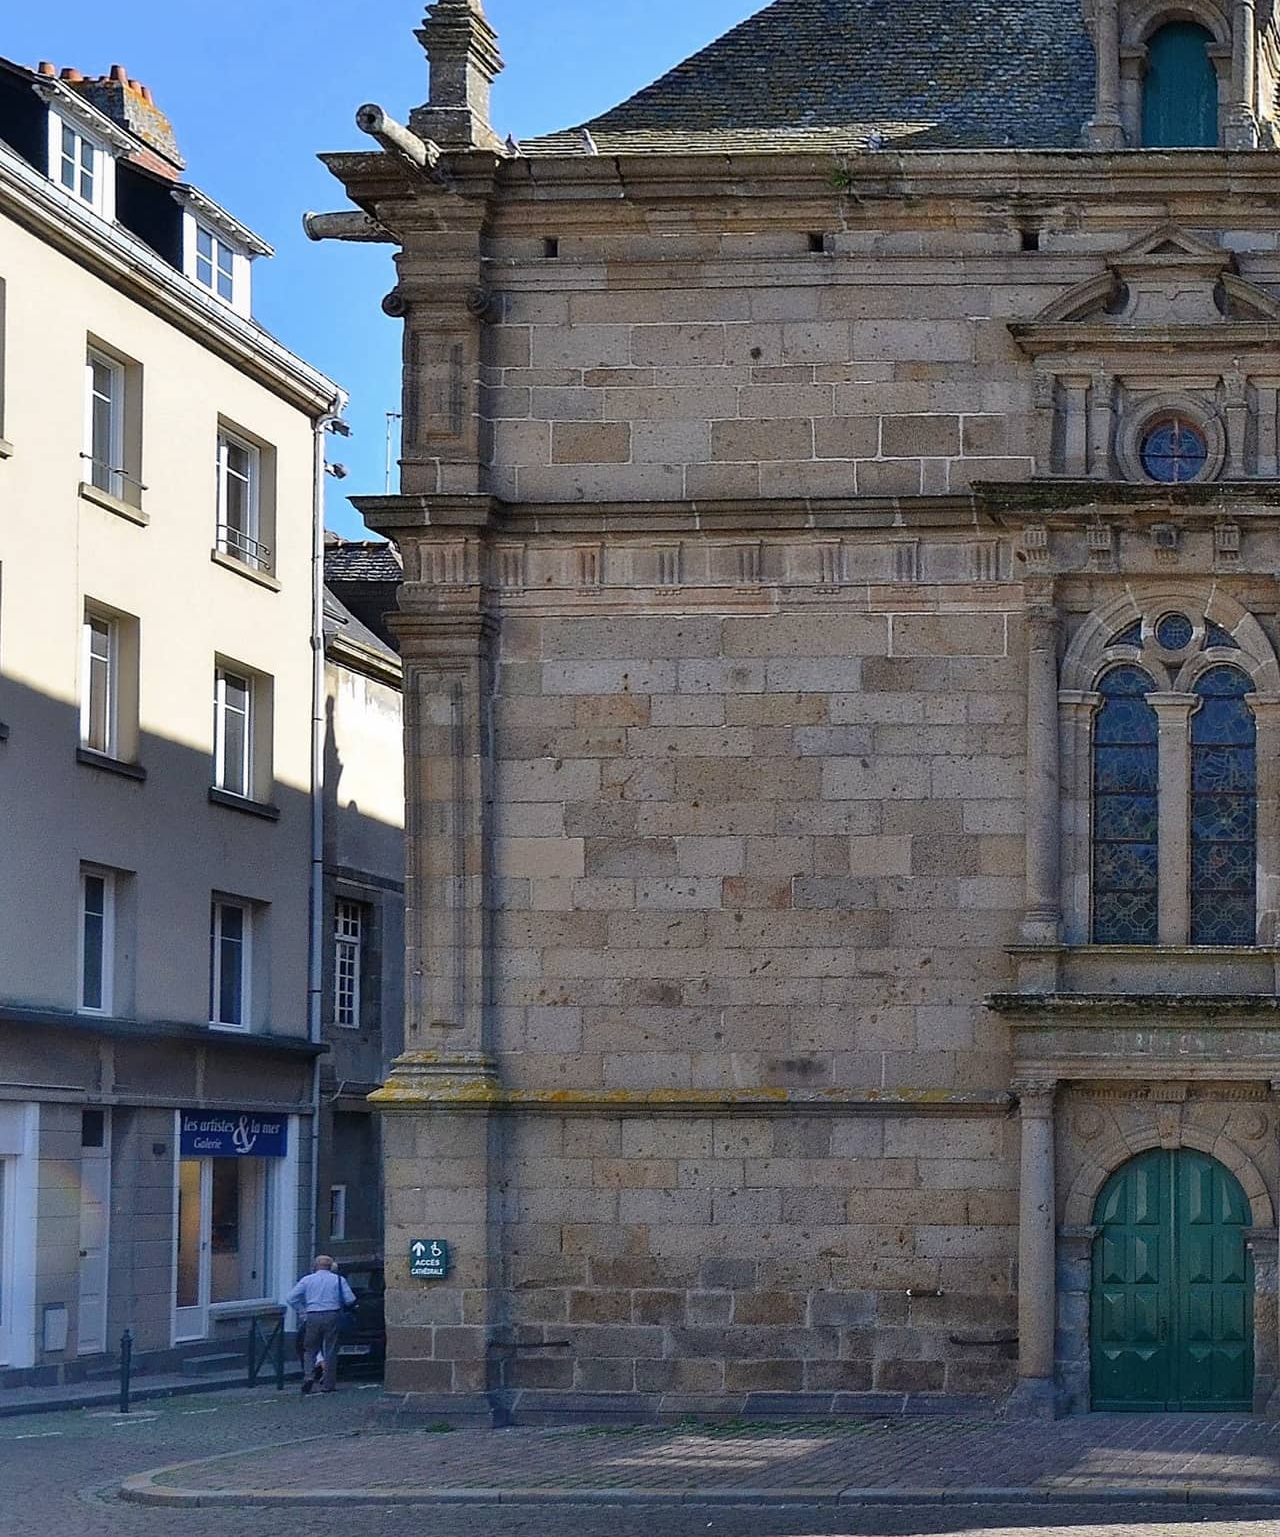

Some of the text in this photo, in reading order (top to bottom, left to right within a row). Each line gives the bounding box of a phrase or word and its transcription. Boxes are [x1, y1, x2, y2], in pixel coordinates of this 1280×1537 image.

[193, 1136, 222, 1149] Galerie
[200, 1118, 234, 1133] artistes
[232, 1114, 257, 1154] &
[251, 1119, 260, 1134] la
[262, 1123, 280, 1134] mer
